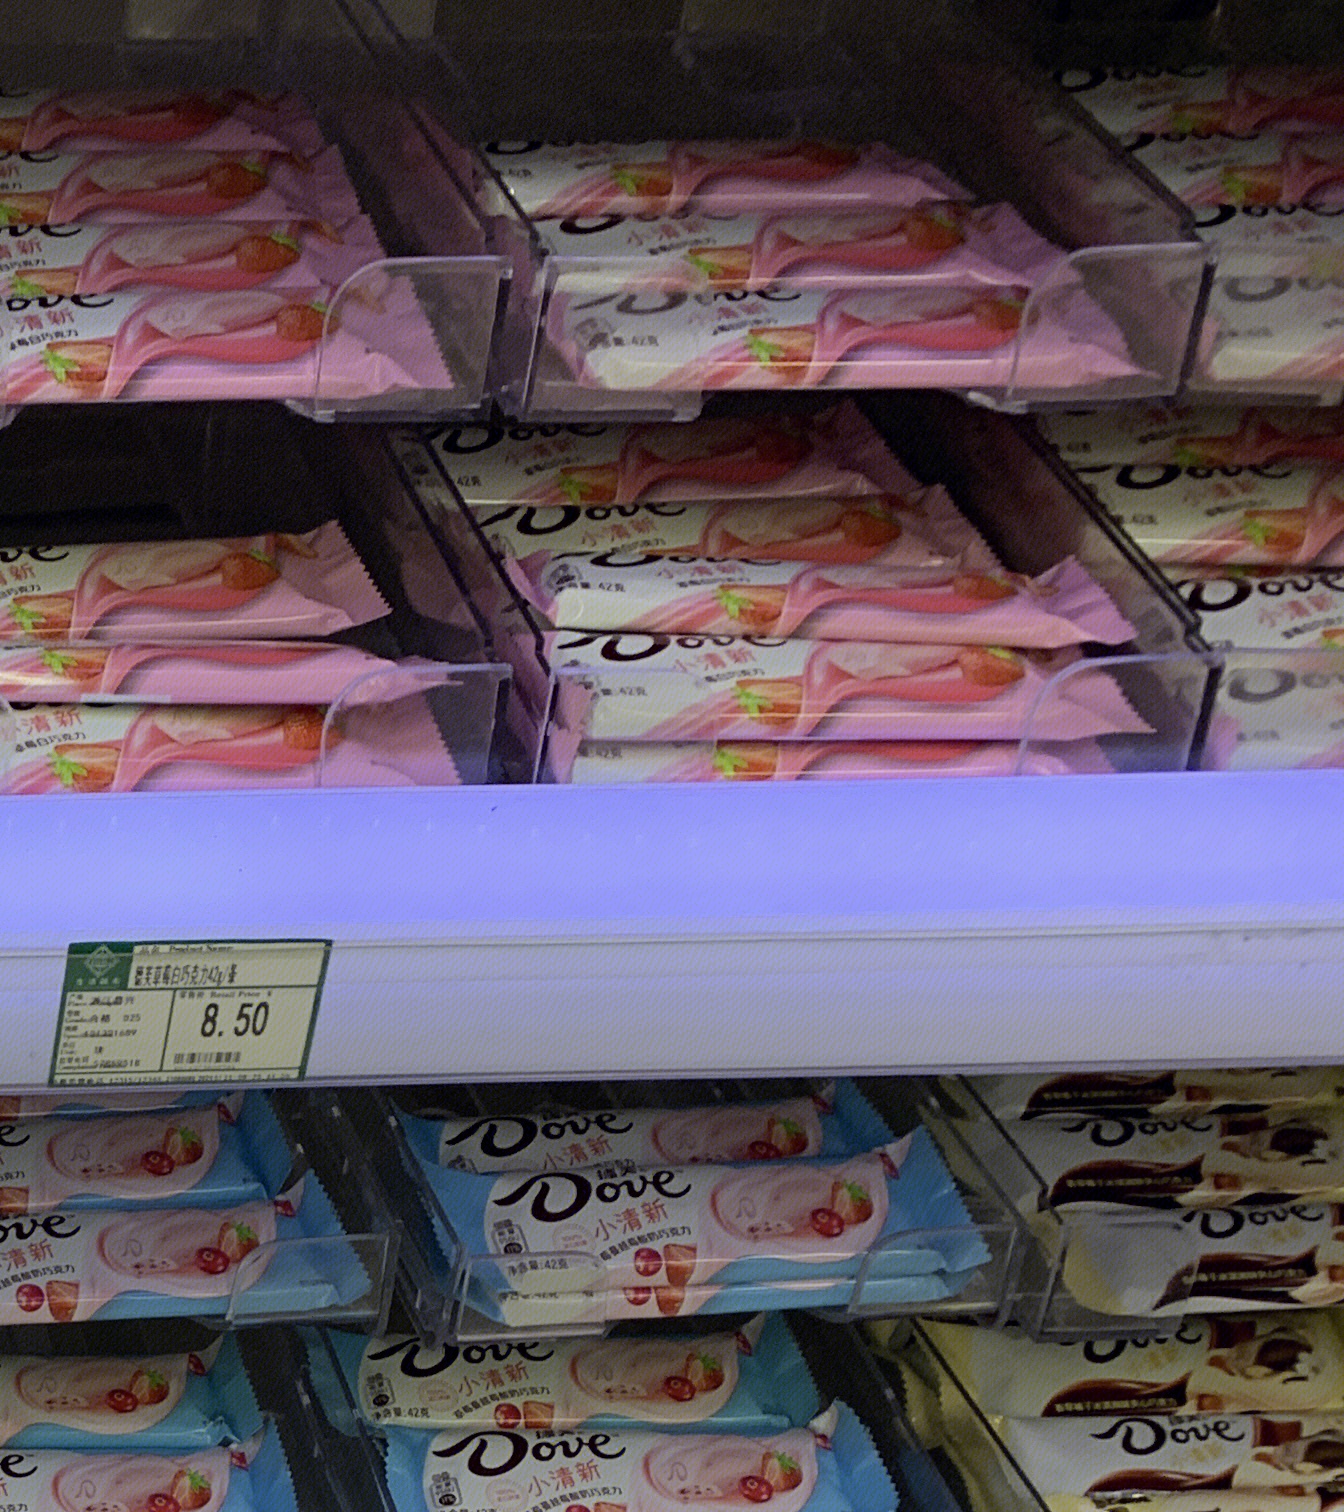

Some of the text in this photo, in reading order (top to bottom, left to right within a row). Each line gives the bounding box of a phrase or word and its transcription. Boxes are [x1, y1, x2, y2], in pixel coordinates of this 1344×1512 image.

[201, 1001, 269, 1038] 8.50
[493, 1168, 692, 1223] Dove
[592, 1200, 668, 1244] 小清新
[457, 1362, 530, 1397] 小清新
[433, 1431, 627, 1477] Dove
[526, 1459, 603, 1499] 小清新
